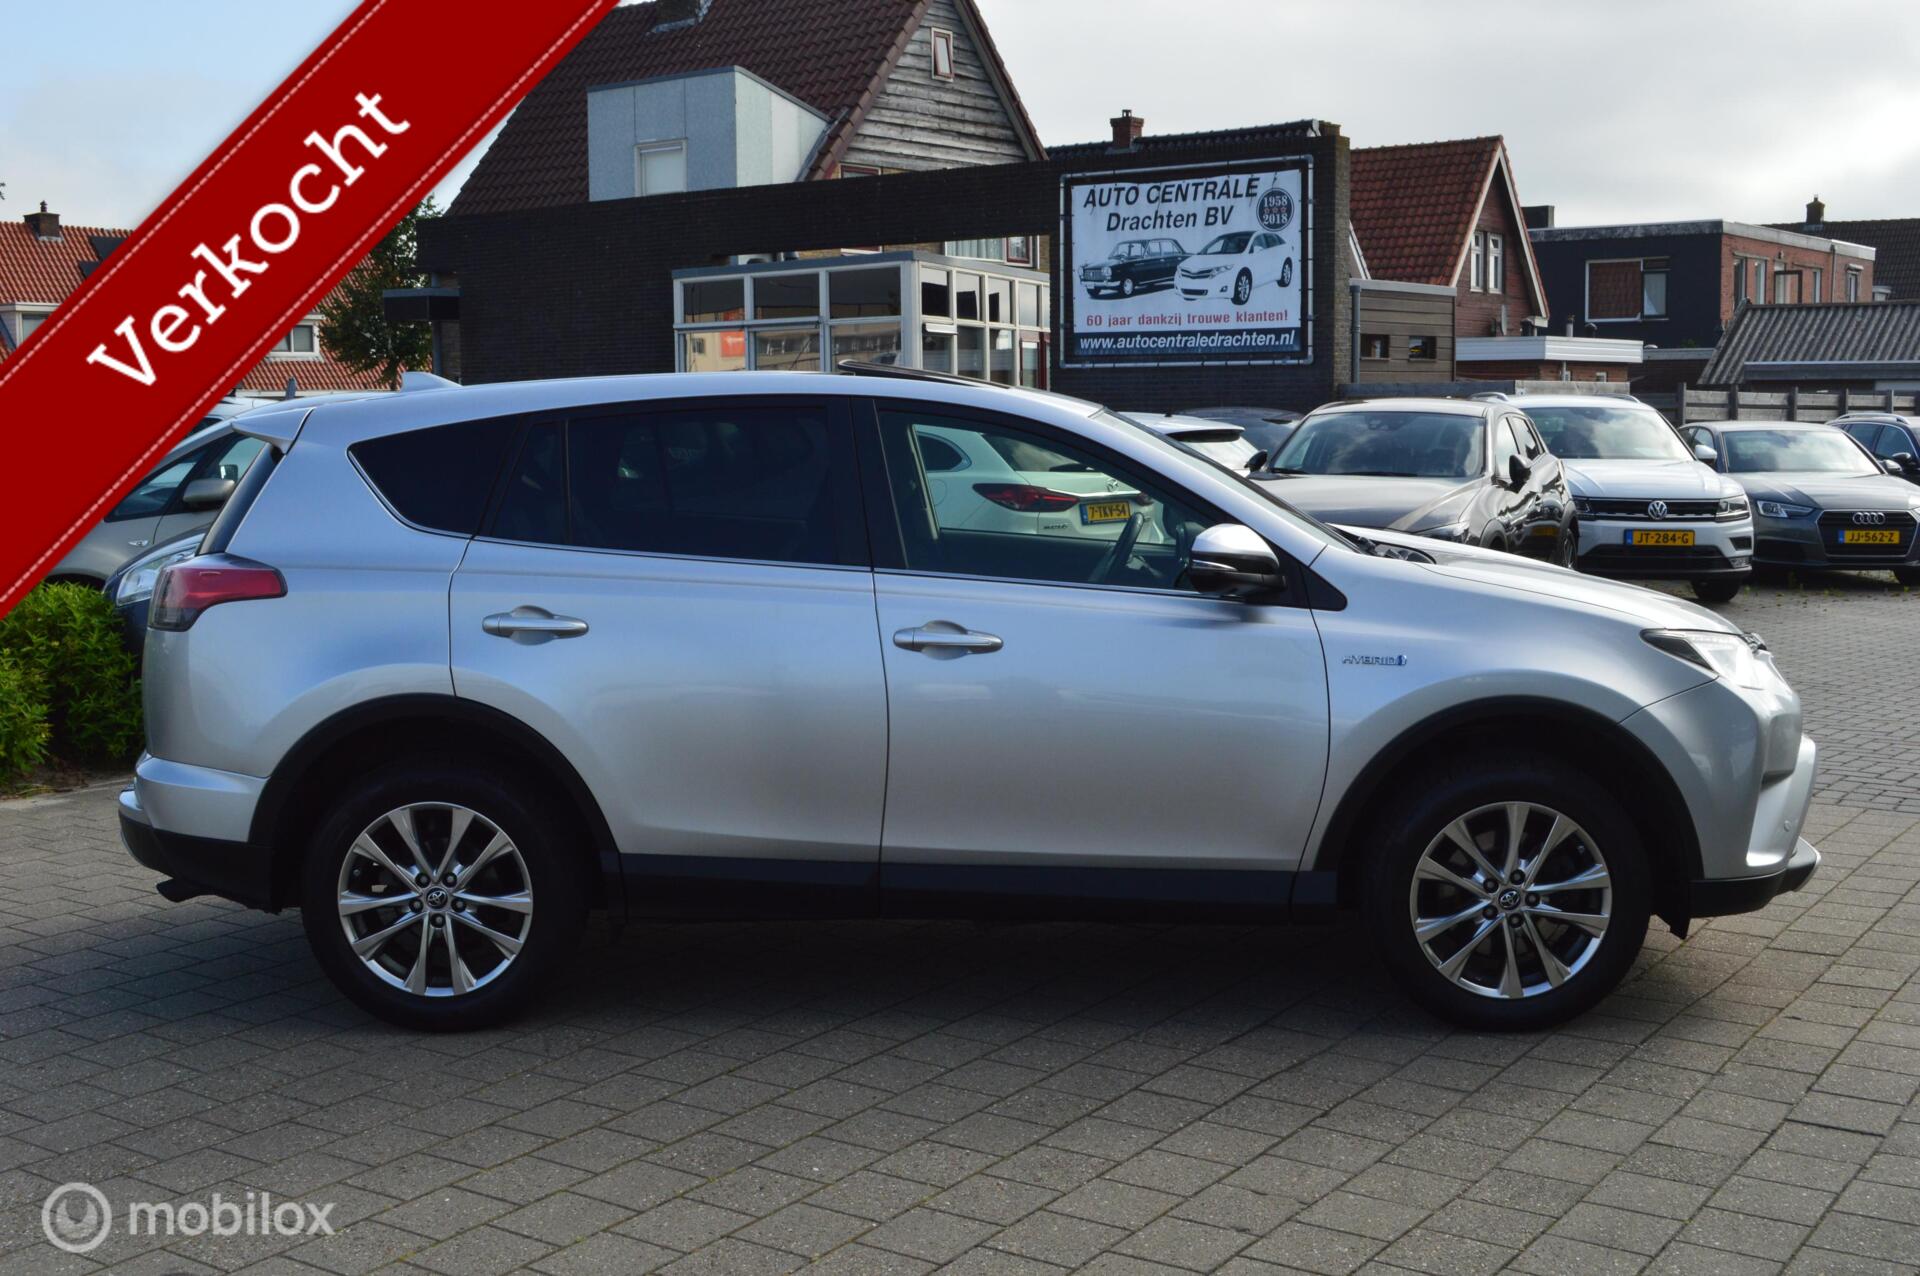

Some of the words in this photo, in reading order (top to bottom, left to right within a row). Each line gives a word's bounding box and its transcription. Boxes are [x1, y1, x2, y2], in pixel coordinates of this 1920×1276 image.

[1083, 185, 1139, 208] AUTO
[1146, 177, 1260, 204] CENTRALE
[1263, 195, 1288, 207] 1958
[1106, 209, 1197, 232] Drachten
[1204, 205, 1234, 226] BV
[1262, 213, 1288, 225] 2018
[1086, 314, 1102, 326] 60
[1108, 314, 1132, 327] jaar
[1138, 312, 1182, 326] dankzij
[1187, 312, 1230, 324] trouwe
[1236, 310, 1288, 323] klanten!
[1080, 330, 1295, 349] www.autocentraledrachten.nl
[1636, 532, 1690, 544] JT-284-G
